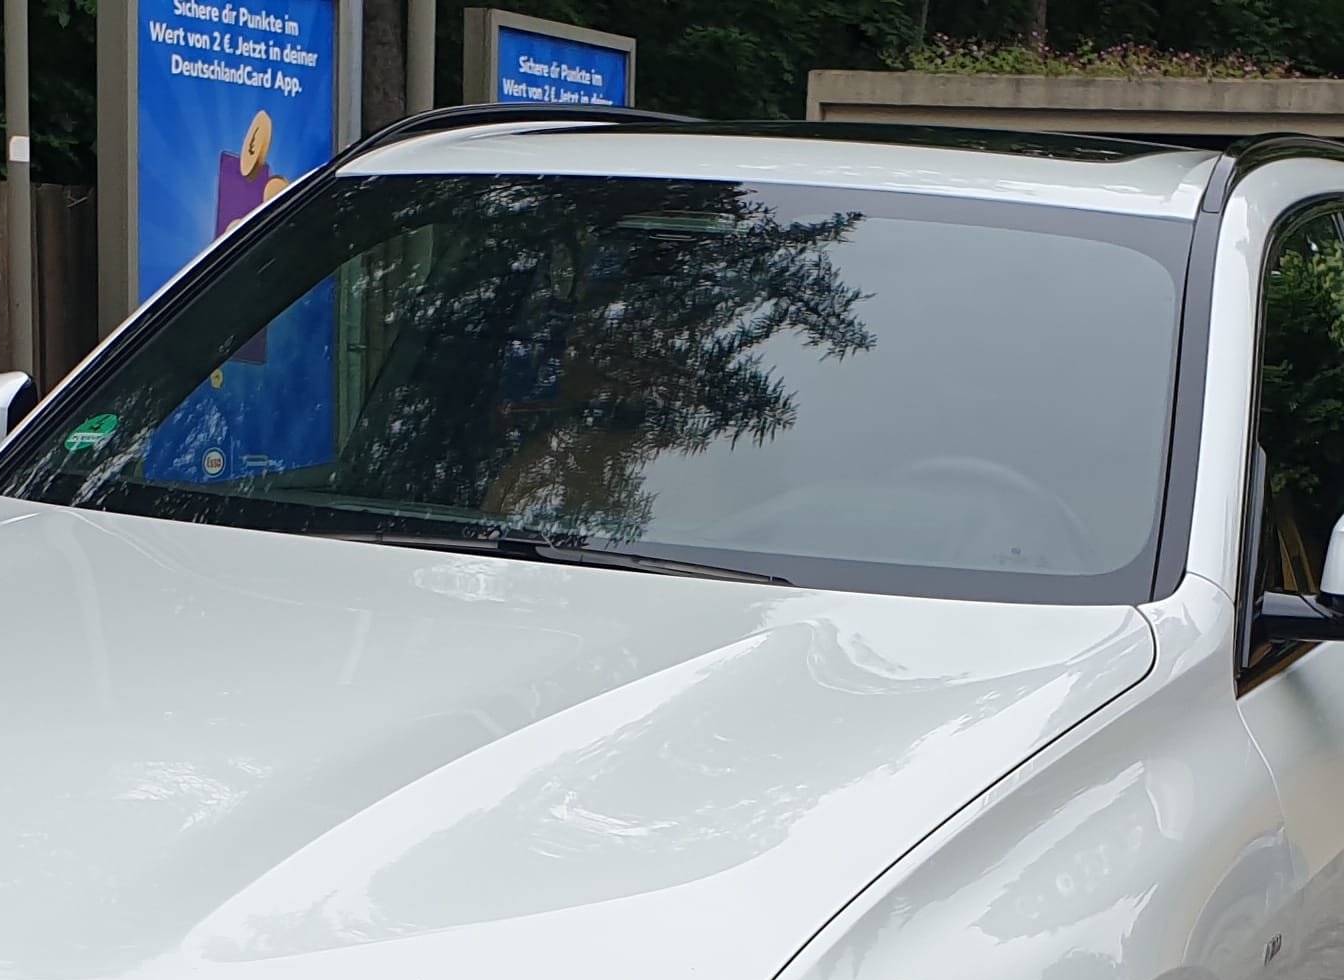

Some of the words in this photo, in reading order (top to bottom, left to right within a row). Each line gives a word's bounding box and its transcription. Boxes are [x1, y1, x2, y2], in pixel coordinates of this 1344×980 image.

[174, 0, 219, 21] Sichere
[222, 4, 237, 24] dir
[239, 8, 282, 33] Punkte
[285, 15, 299, 36] im
[149, 20, 185, 46] Wert
[187, 32, 210, 50] von
[213, 32, 221, 51] 2
[235, 36, 266, 60] Jetzt
[269, 41, 281, 61] in
[283, 45, 318, 67] deiner
[171, 54, 271, 88] DeutschlandCard
[274, 71, 303, 97] App.
[519, 56, 549, 77] Sichere
[550, 61, 561, 79] dir
[561, 64, 591, 85] Punkte
[591, 69, 603, 86] im
[502, 78, 527, 98] Wert
[528, 86, 543, 100] von
[544, 85, 551, 102] 2
